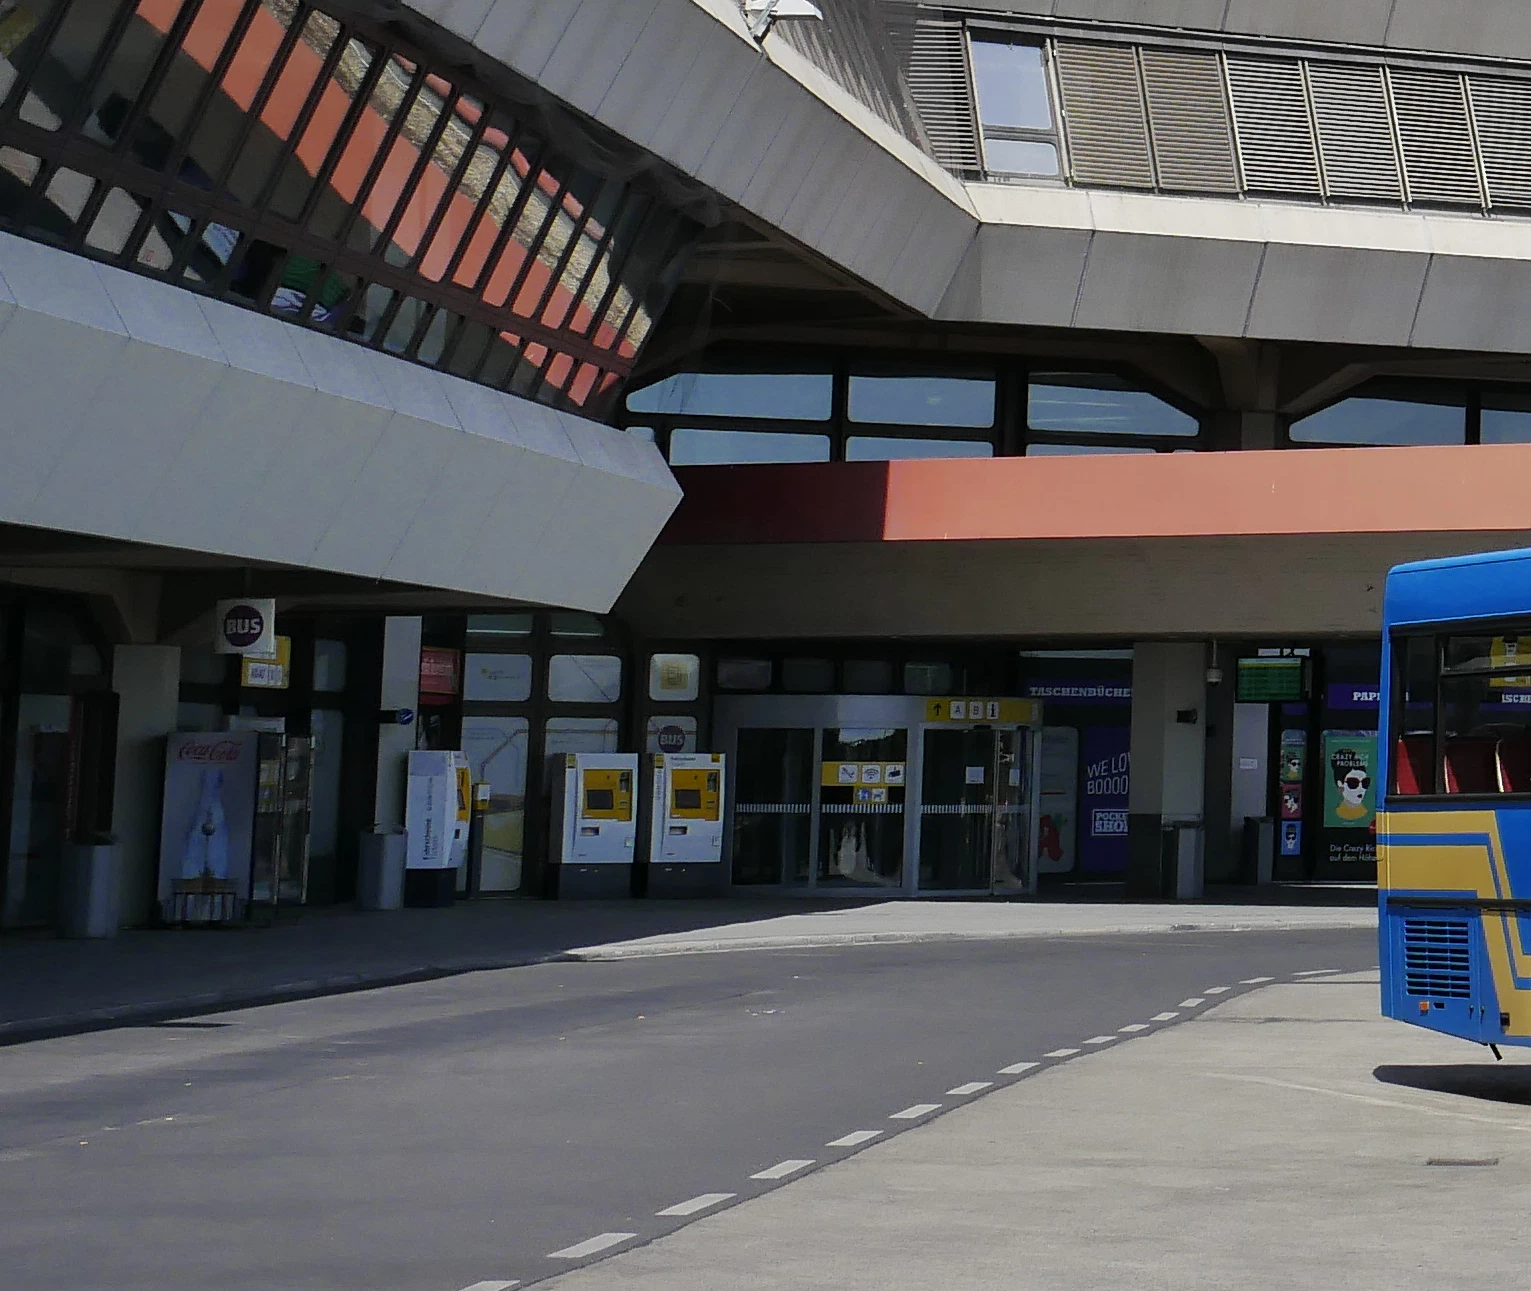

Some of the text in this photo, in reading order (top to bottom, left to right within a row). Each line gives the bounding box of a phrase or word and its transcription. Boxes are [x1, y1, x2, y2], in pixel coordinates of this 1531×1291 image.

[225, 618, 261, 634] BUS
[1029, 684, 1131, 697] TASCHENBÜCHE
[659, 734, 684, 745] BUS
[1087, 752, 1130, 778] WE LO
[1087, 775, 1129, 795] BOOOO
[1095, 812, 1129, 820] POCKE
